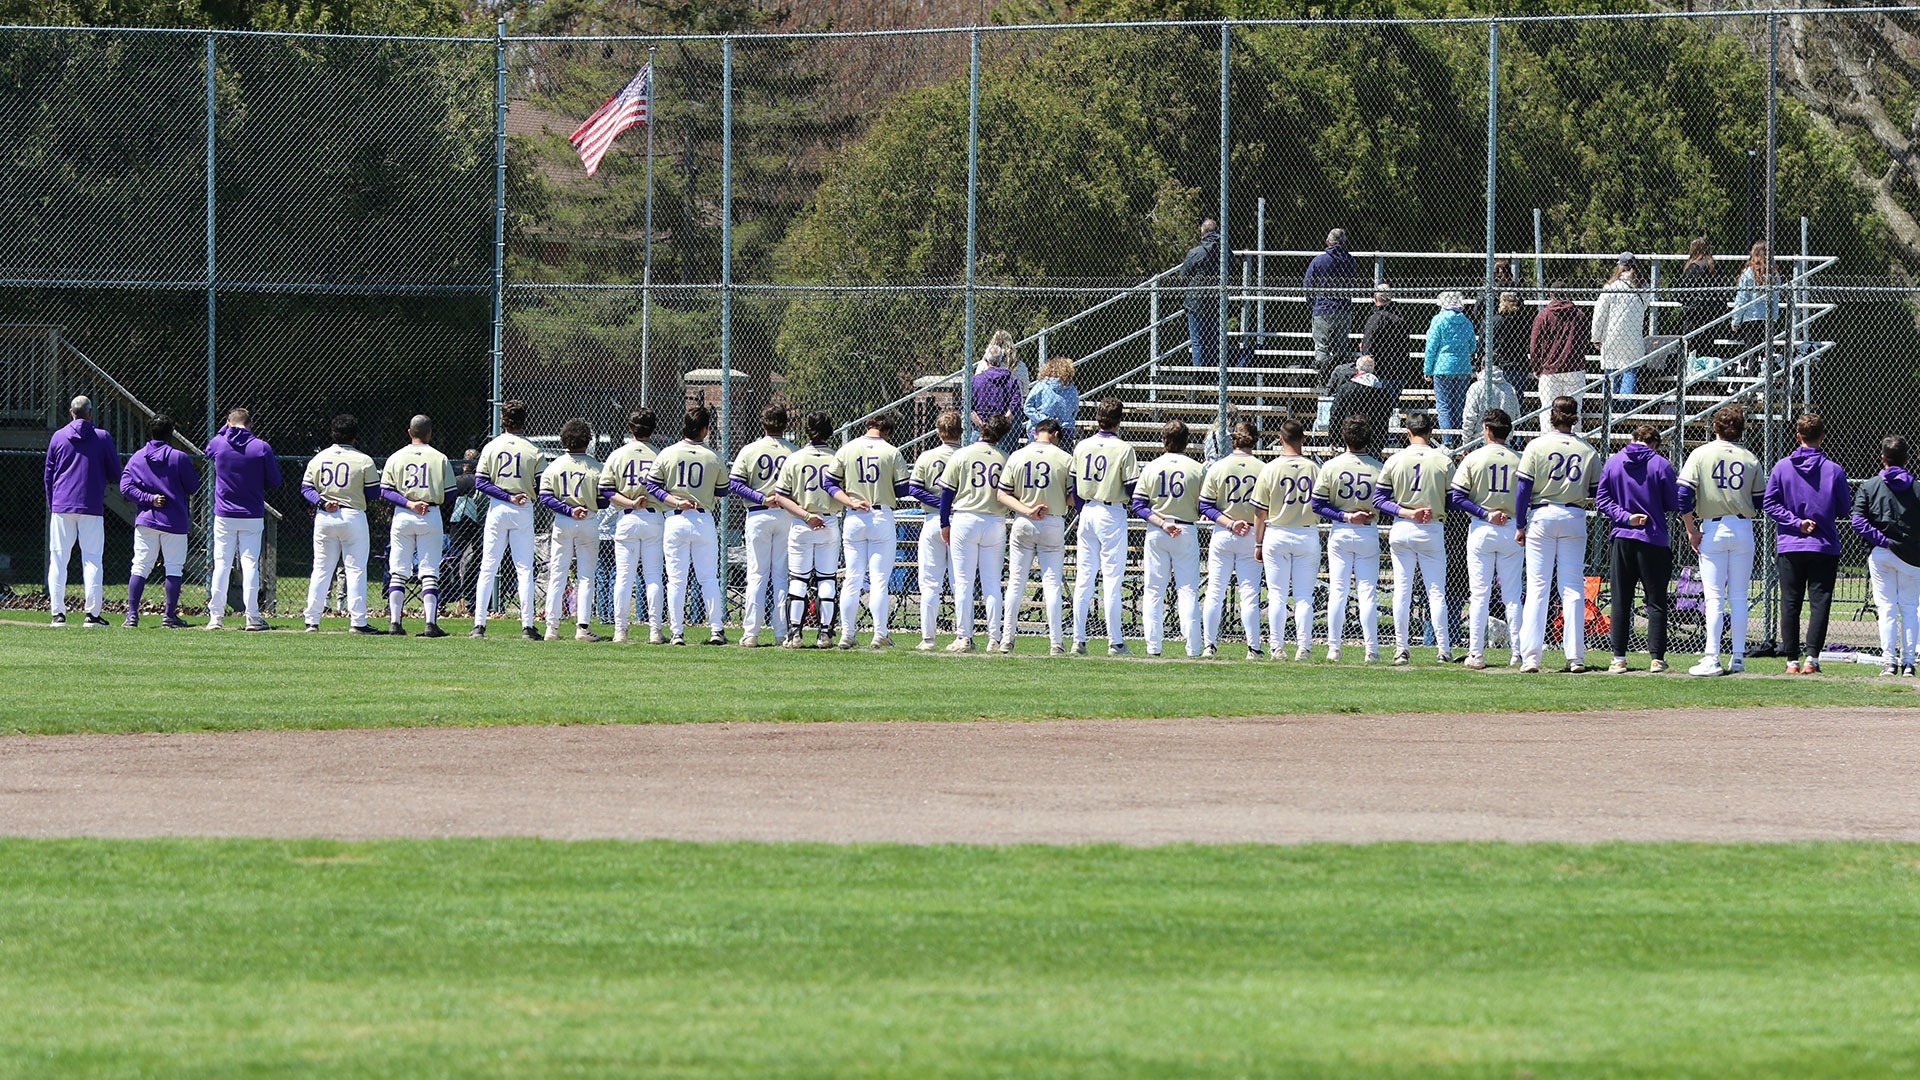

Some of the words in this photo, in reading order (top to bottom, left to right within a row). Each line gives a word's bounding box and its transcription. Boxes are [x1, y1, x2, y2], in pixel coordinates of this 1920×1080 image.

[320, 461, 350, 488] 50
[405, 462, 428, 489] 31
[497, 451, 521, 479] 21
[623, 460, 652, 485] 45
[677, 461, 703, 488] 10
[856, 456, 880, 483] 15
[971, 461, 1001, 488] 36
[1023, 461, 1050, 489] 13
[1083, 453, 1107, 482] 19
[1411, 463, 1421, 492] 1
[1488, 464, 1510, 493] 11
[1548, 452, 1582, 482] 26
[1711, 459, 1745, 490] 48
[560, 470, 586, 498] 17
[1157, 470, 1185, 498] 16
[1225, 475, 1256, 503] 22
[1280, 476, 1312, 504] 29
[1337, 471, 1373, 501] 35
